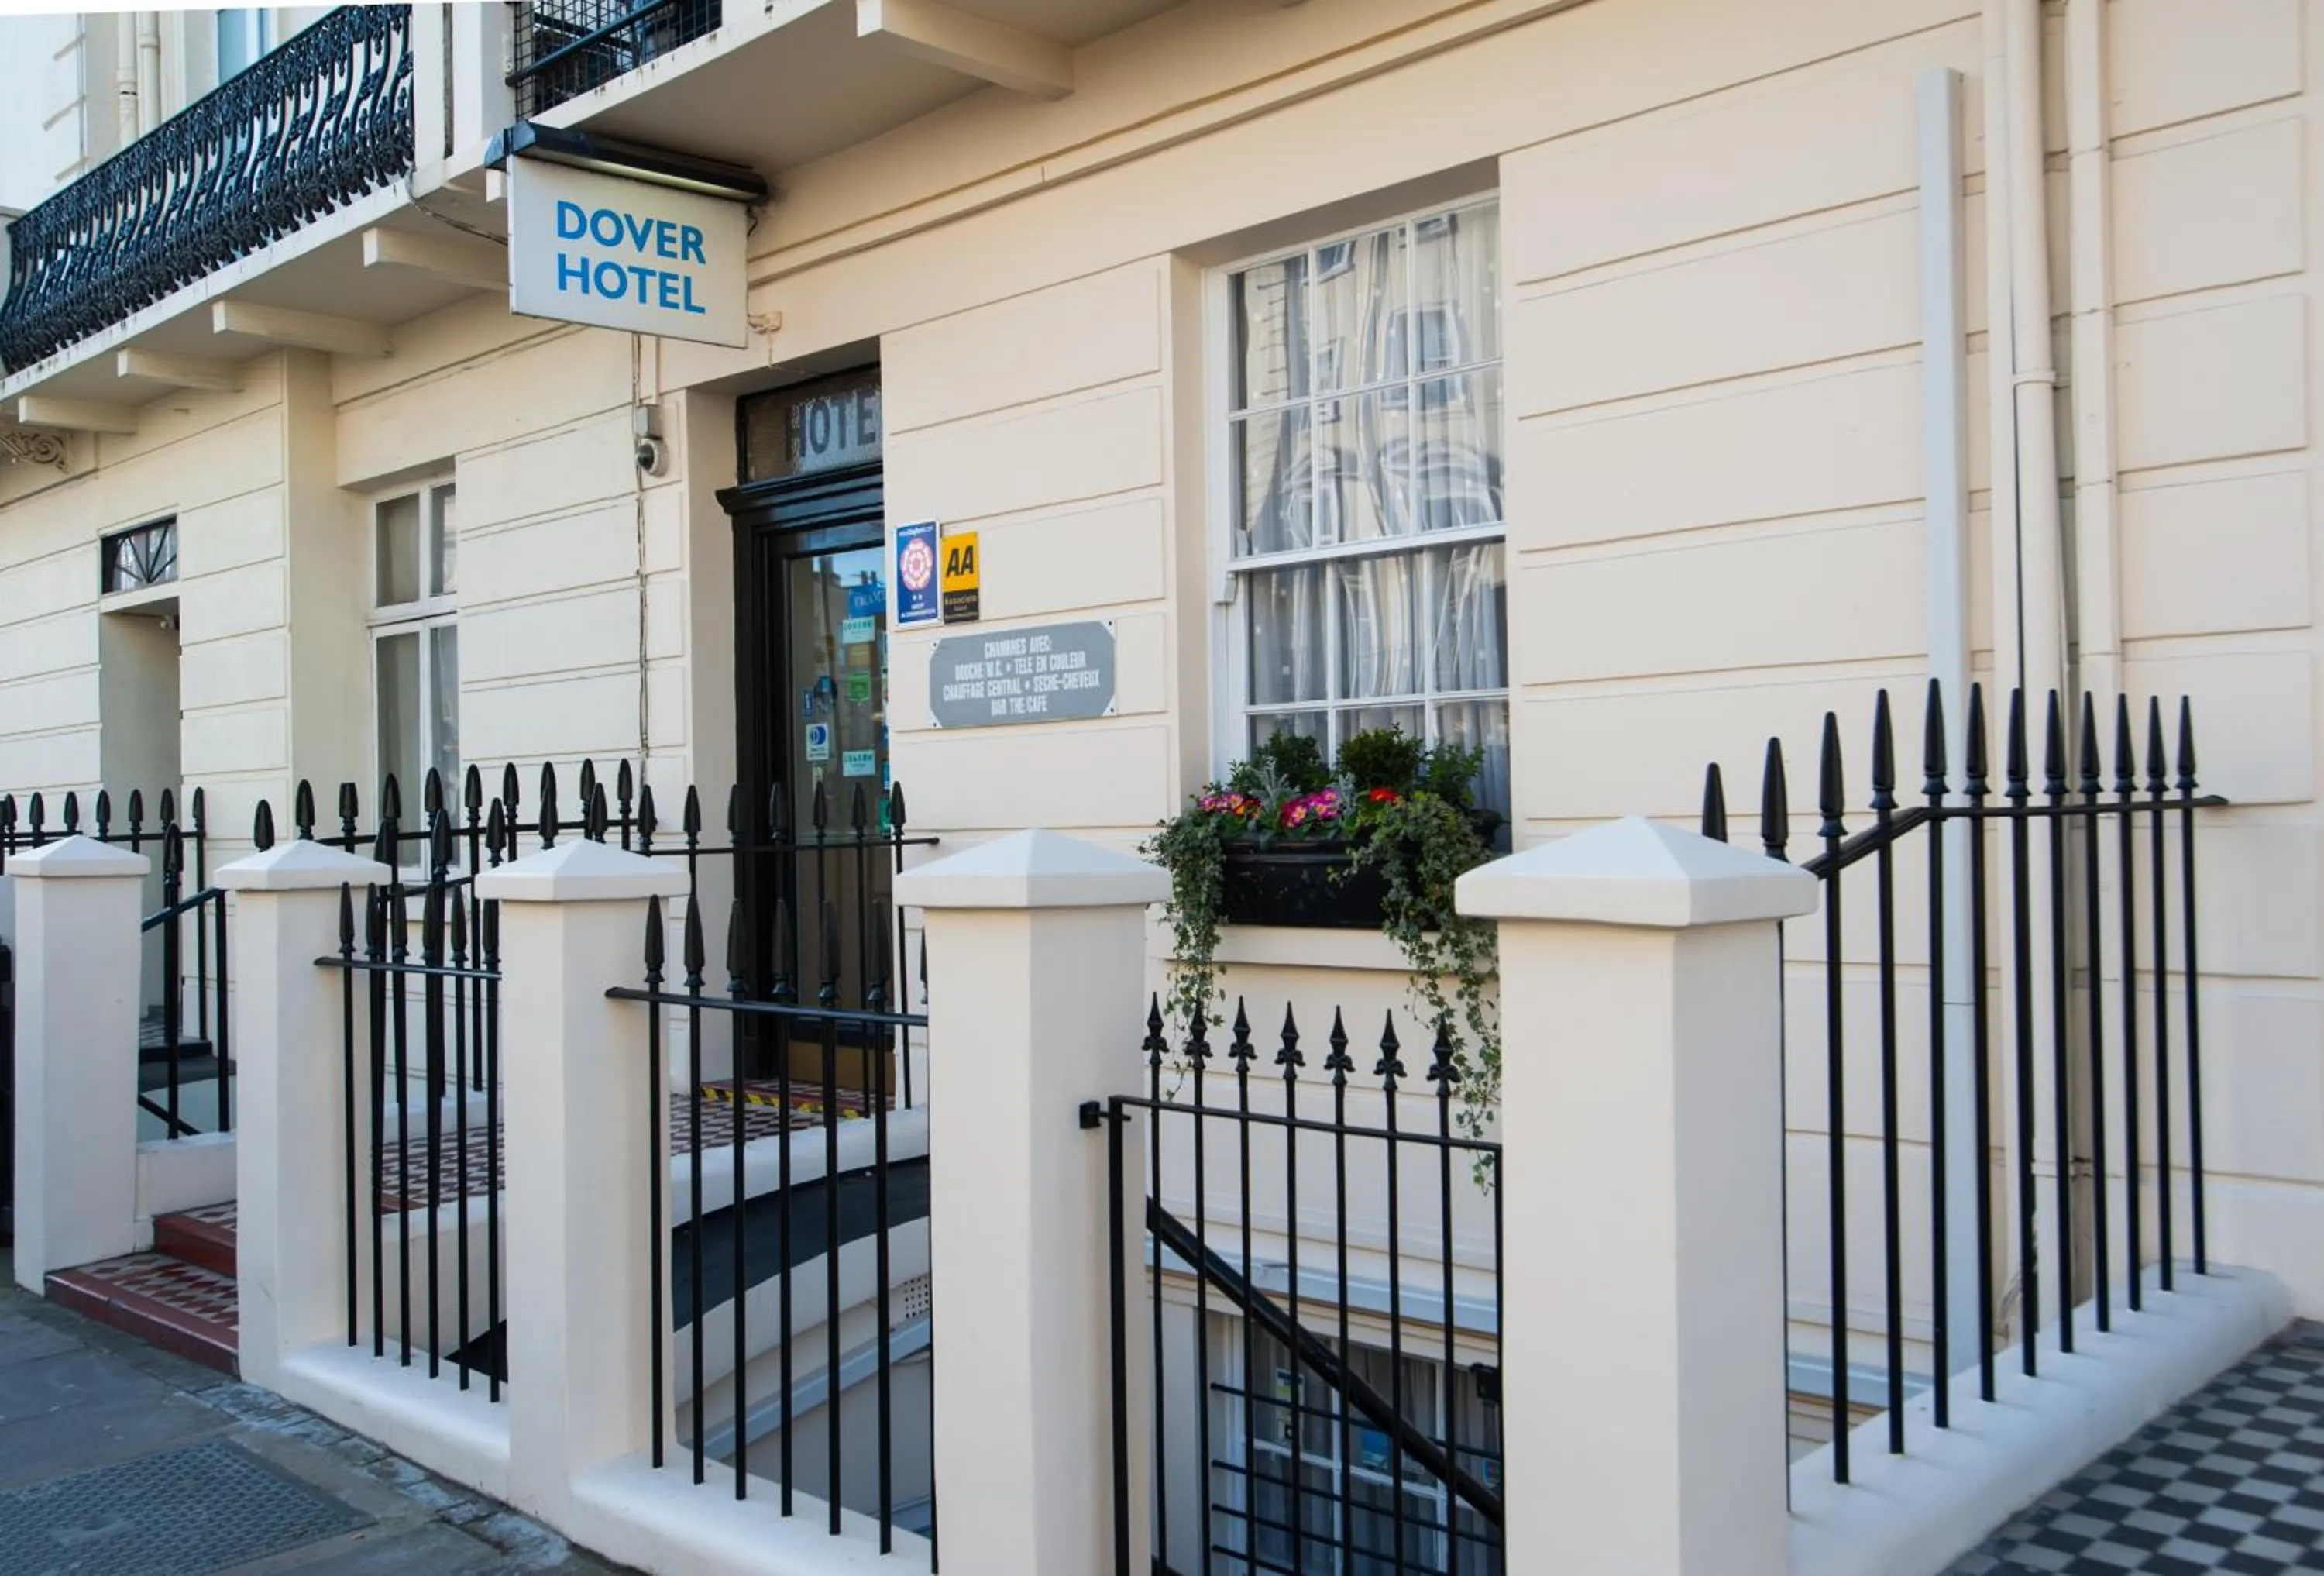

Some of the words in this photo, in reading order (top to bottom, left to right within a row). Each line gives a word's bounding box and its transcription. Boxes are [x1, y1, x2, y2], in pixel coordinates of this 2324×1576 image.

[557, 200, 706, 264] DOVER
[557, 253, 706, 315] HOTEL
[785, 387, 878, 462] HOTE
[946, 545, 974, 578] AA
[985, 638, 1026, 659] CHAMBRES
[1014, 656, 1033, 675] TELE
[1036, 655, 1047, 673] EN
[1049, 650, 1086, 672] COULEUR
[1009, 697, 1026, 715] THE
[1026, 694, 1047, 713] CAFE
